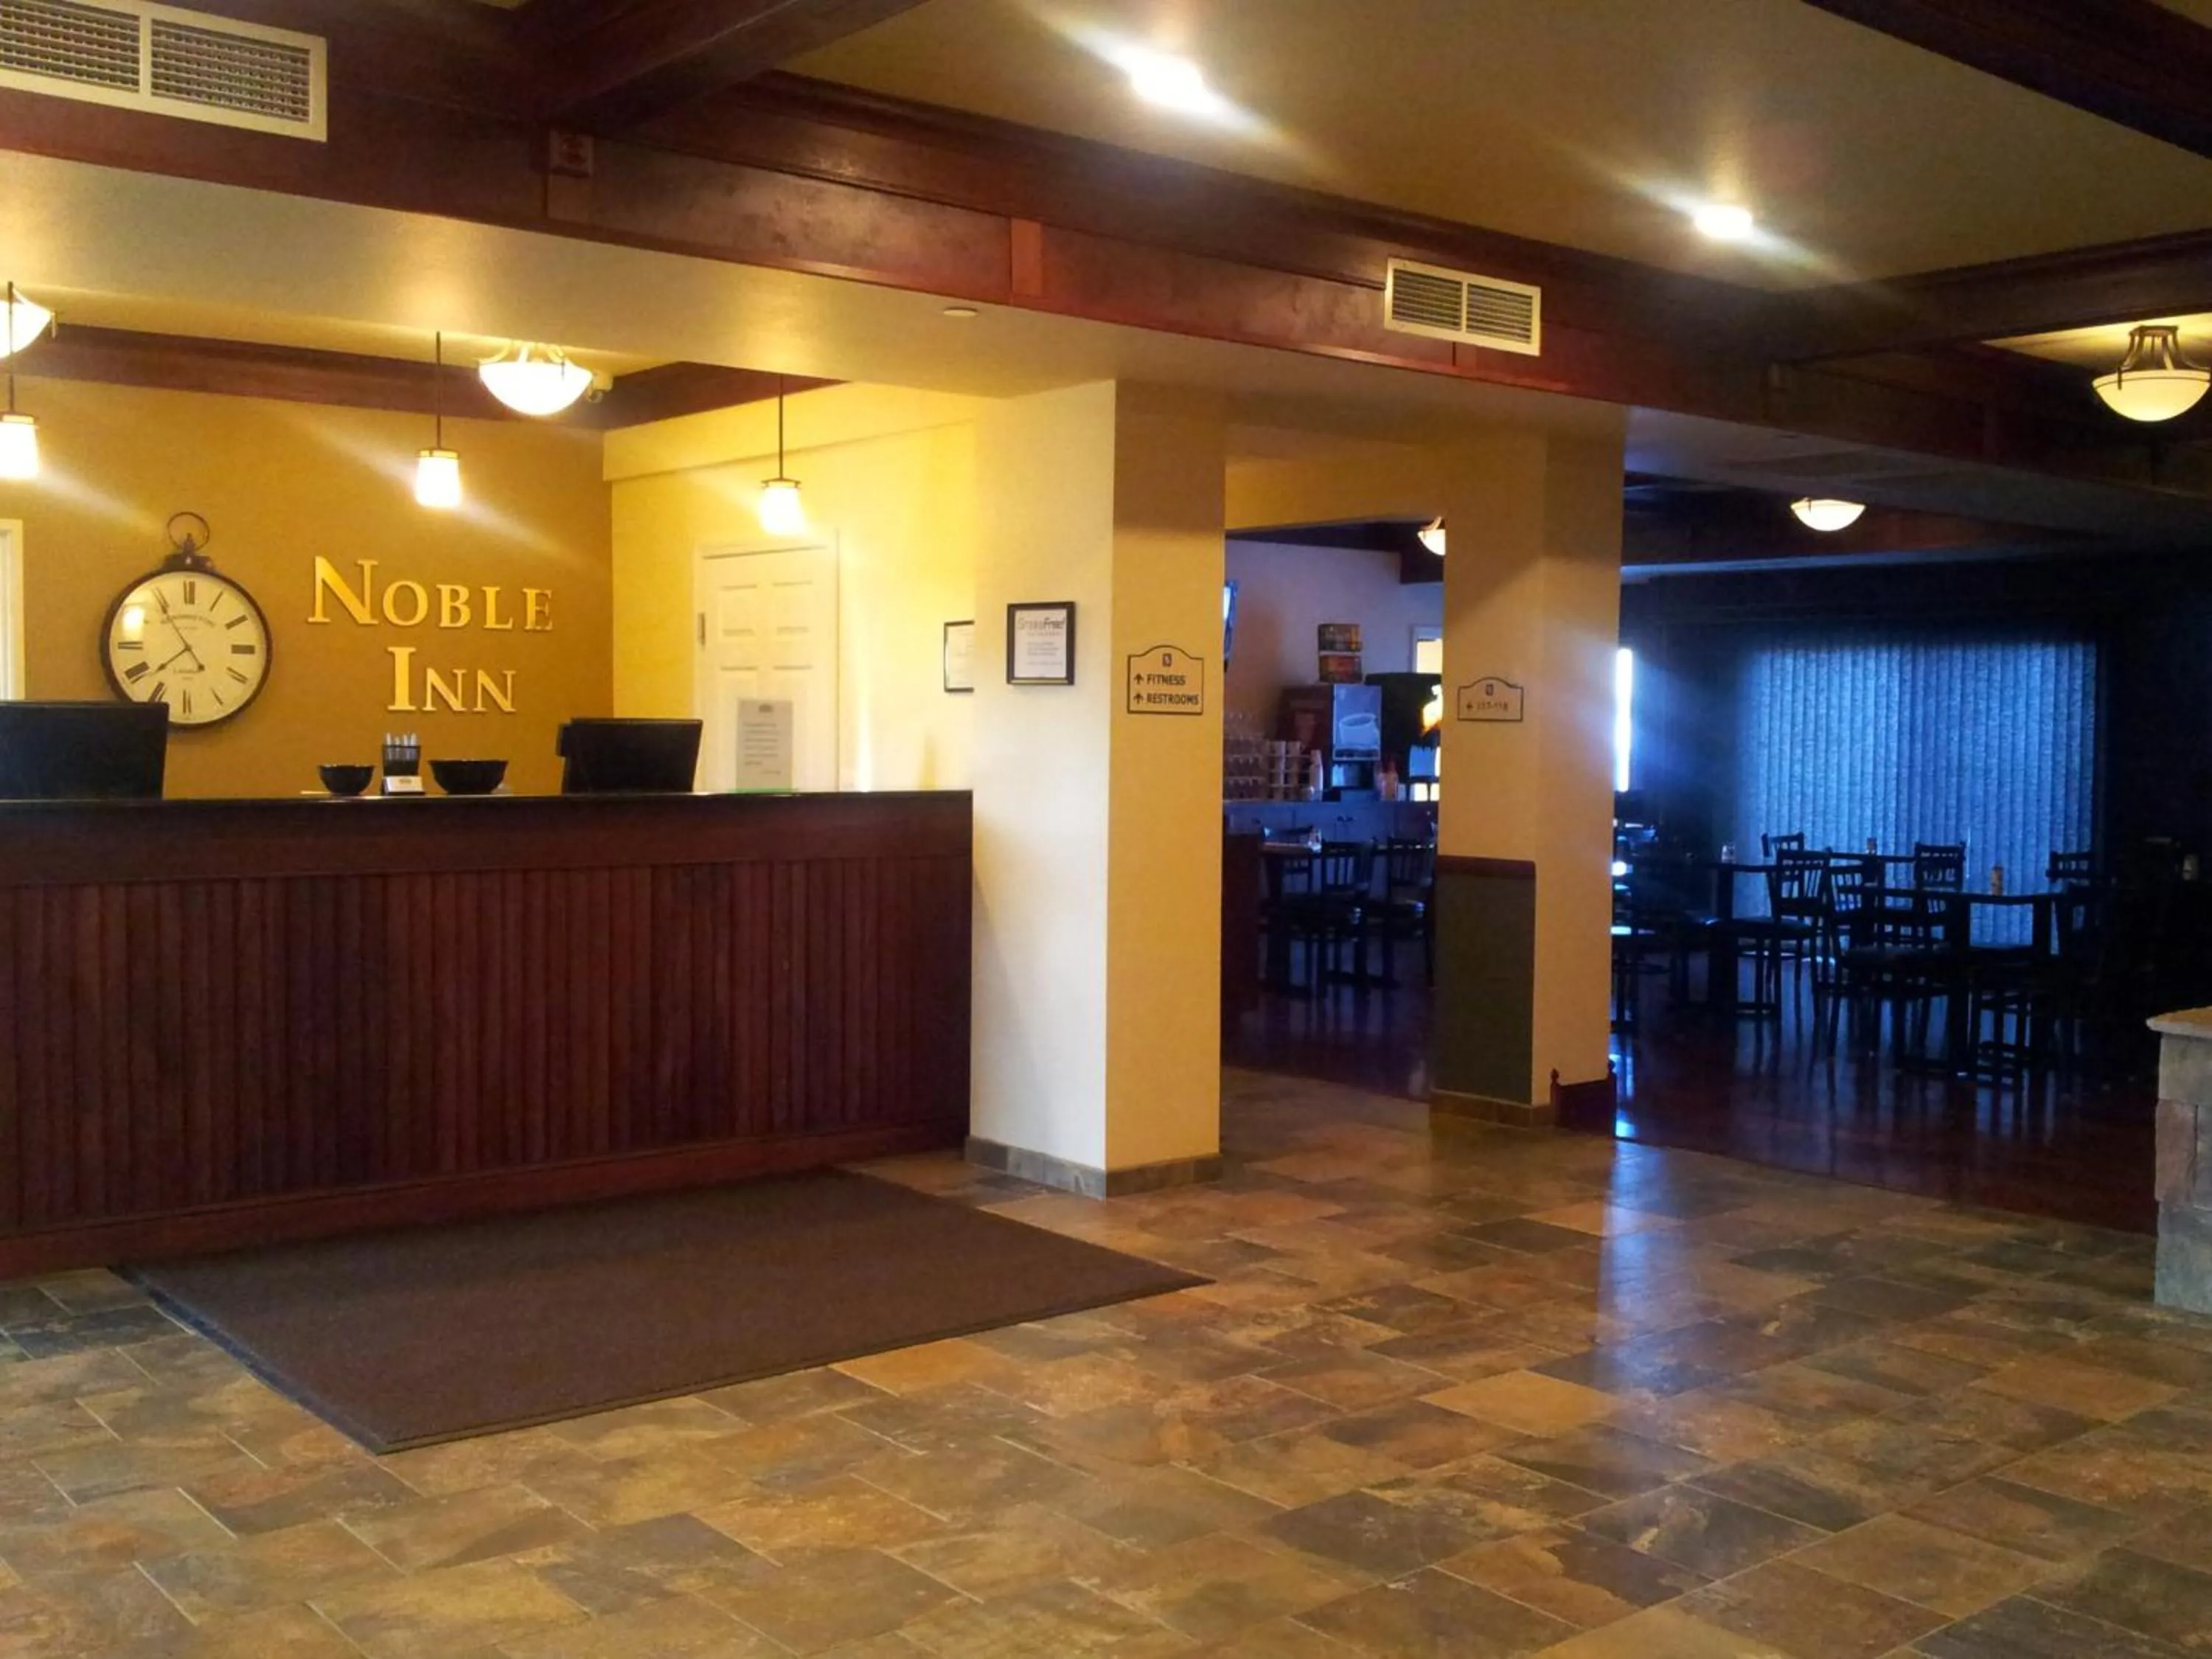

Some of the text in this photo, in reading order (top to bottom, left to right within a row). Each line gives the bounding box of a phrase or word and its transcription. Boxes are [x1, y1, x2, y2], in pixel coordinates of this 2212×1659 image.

[307, 555, 553, 631] NOBLE
[386, 646, 517, 713] INN
[1146, 692, 1200, 706] RESTROOMS
[1147, 673, 1186, 686] FITNESS
